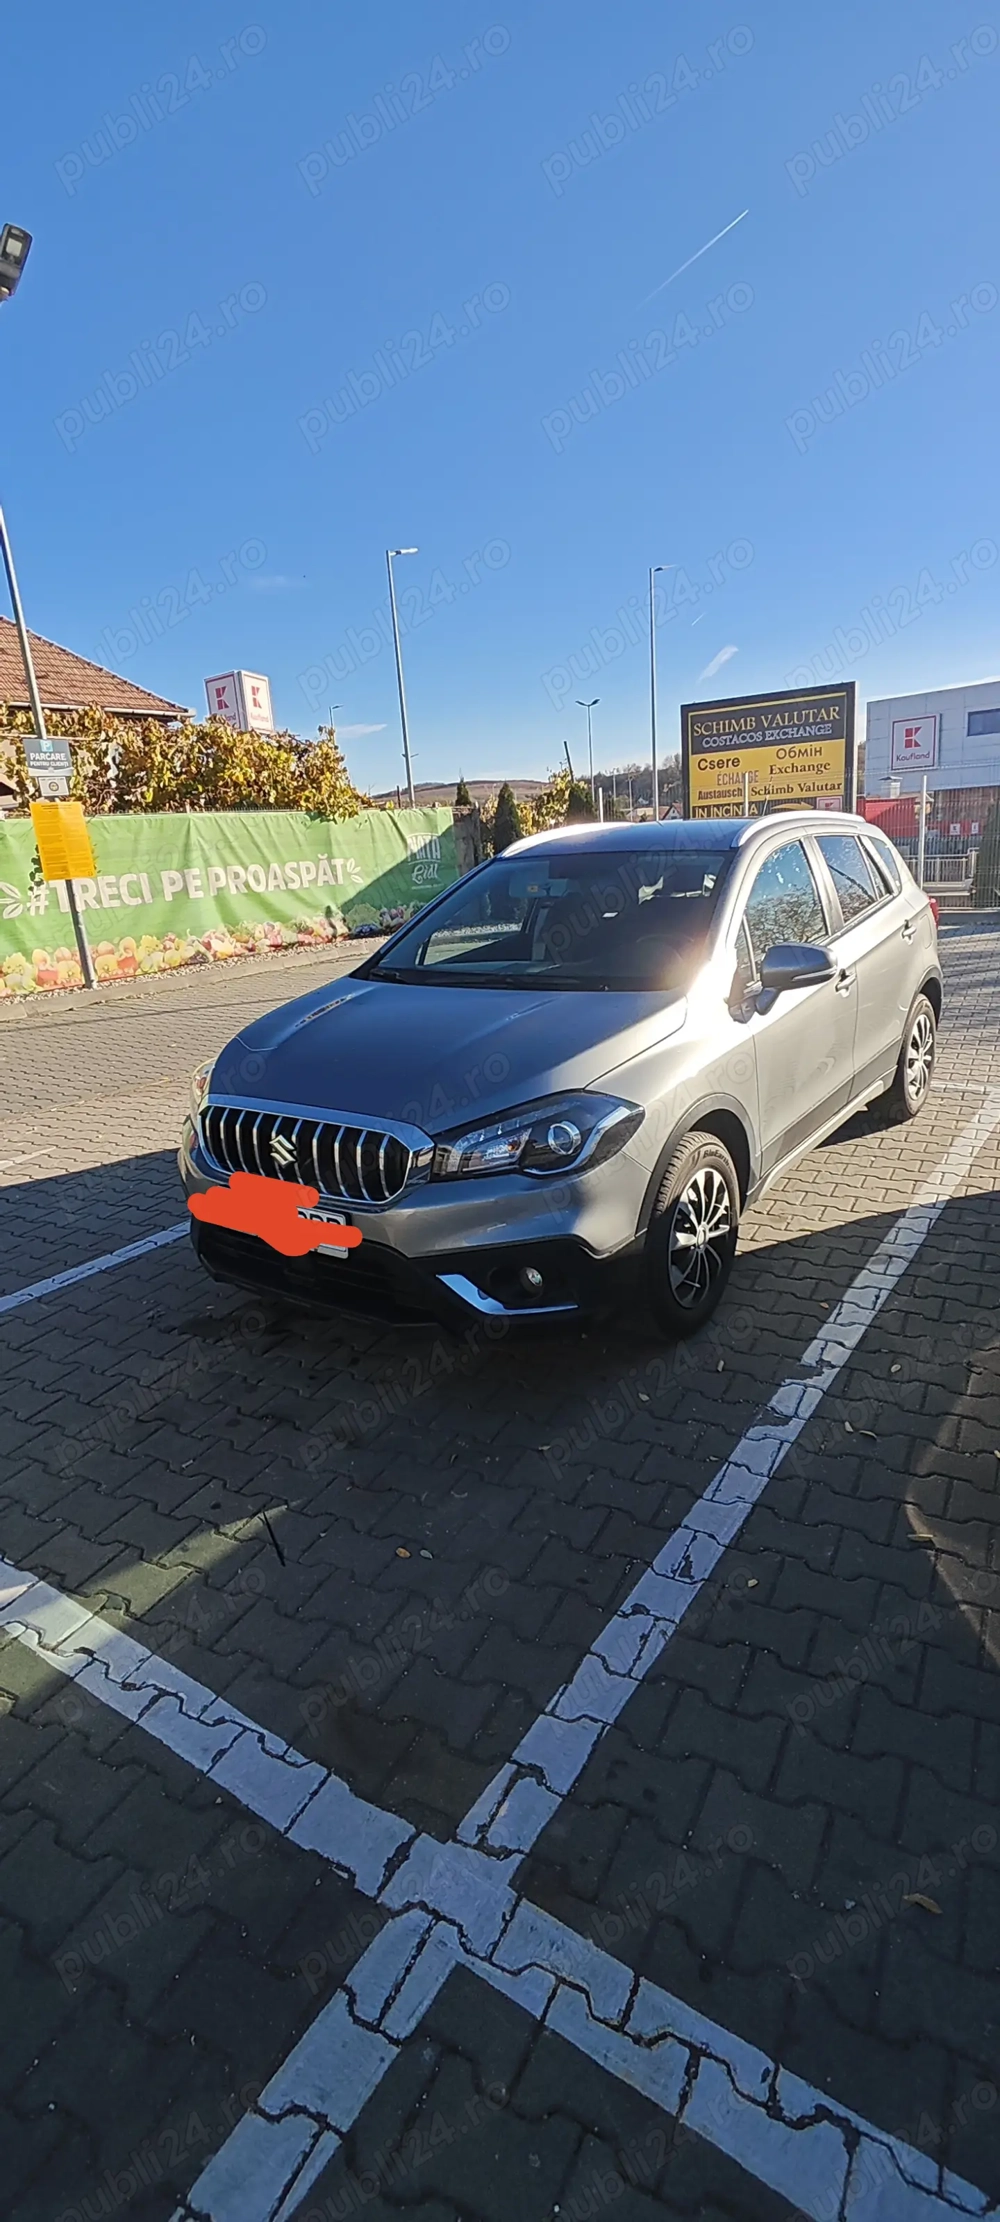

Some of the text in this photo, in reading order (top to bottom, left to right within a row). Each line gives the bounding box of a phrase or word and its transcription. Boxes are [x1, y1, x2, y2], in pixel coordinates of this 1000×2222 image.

[693, 706, 840, 737] SCHIMB VALUTAR
[702, 724, 832, 748] COSTACOS EXCHANGE
[29, 752, 67, 761] PARCARE
[776, 744, 823, 760] Обмін
[896, 750, 931, 762] Kaufland
[697, 757, 741, 771] Csere
[769, 762, 831, 776] Exchange
[698, 786, 743, 801] Austausch
[750, 781, 843, 797] Schimb Valutar
[162, 867, 205, 902] PE
[208, 853, 346, 897] PROASPĂT
